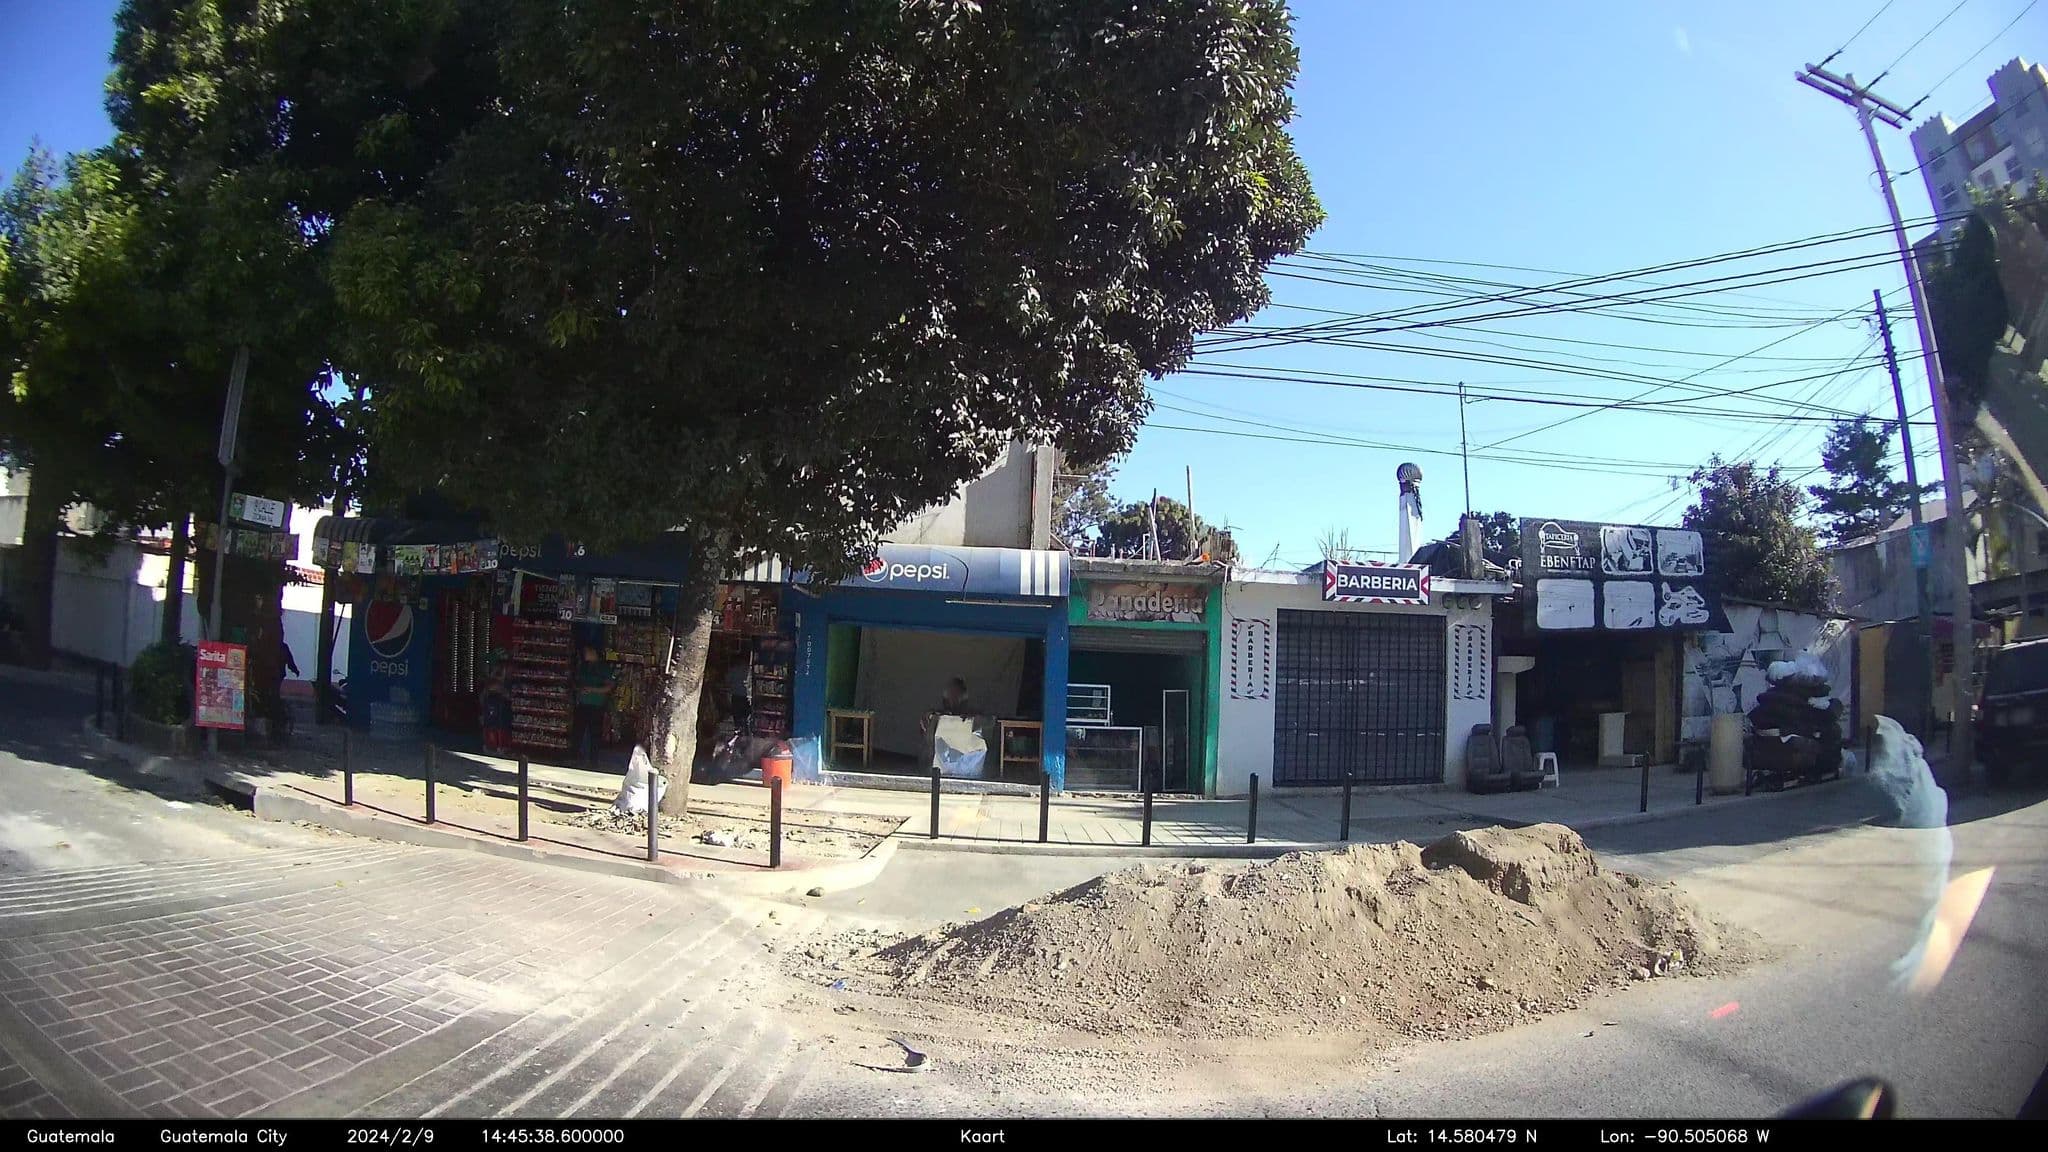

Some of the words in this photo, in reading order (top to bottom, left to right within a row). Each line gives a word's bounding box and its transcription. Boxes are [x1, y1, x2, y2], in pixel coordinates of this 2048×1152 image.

[500, 543, 541, 561] pepsi
[1337, 574, 1418, 591] BARBERIA
[199, 648, 226, 663] Sarita
[371, 659, 409, 678] pepsi
